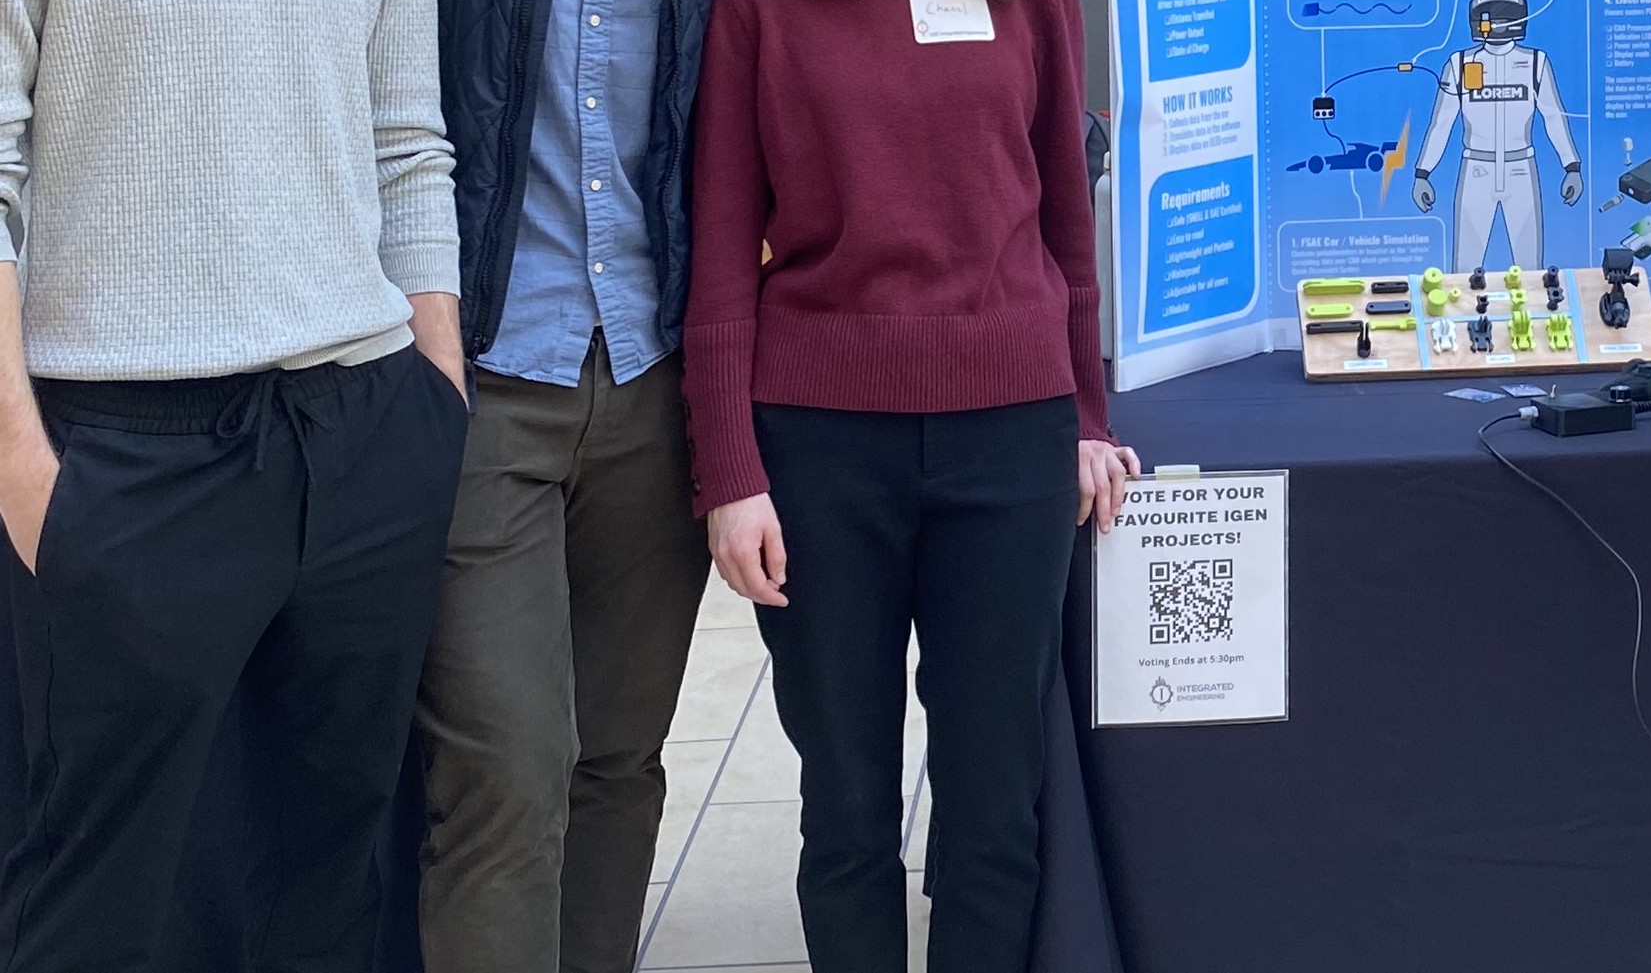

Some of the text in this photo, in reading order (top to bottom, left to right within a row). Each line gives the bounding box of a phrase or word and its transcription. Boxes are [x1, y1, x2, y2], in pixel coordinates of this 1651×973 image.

[1163, 85, 1233, 114] HOW IT WORKS
[1473, 86, 1523, 100] LOREM
[1161, 181, 1230, 211] Requirements
[1301, 237, 1322, 247] FSAE
[1324, 237, 1339, 247] Car
[1349, 235, 1380, 246] Vehicle
[1383, 234, 1429, 245] Simulation
[1172, 489, 1208, 502] FOR
[1213, 486, 1265, 500] YOUR
[1114, 508, 1268, 527] FAVOURITE IGEN
[1141, 532, 1241, 548] PROJECTS!
[1138, 654, 1244, 668] Voting Ends at 5:30pm
[1177, 682, 1234, 693] INTEGRATED
[1177, 693, 1226, 702] ENGINEERING
